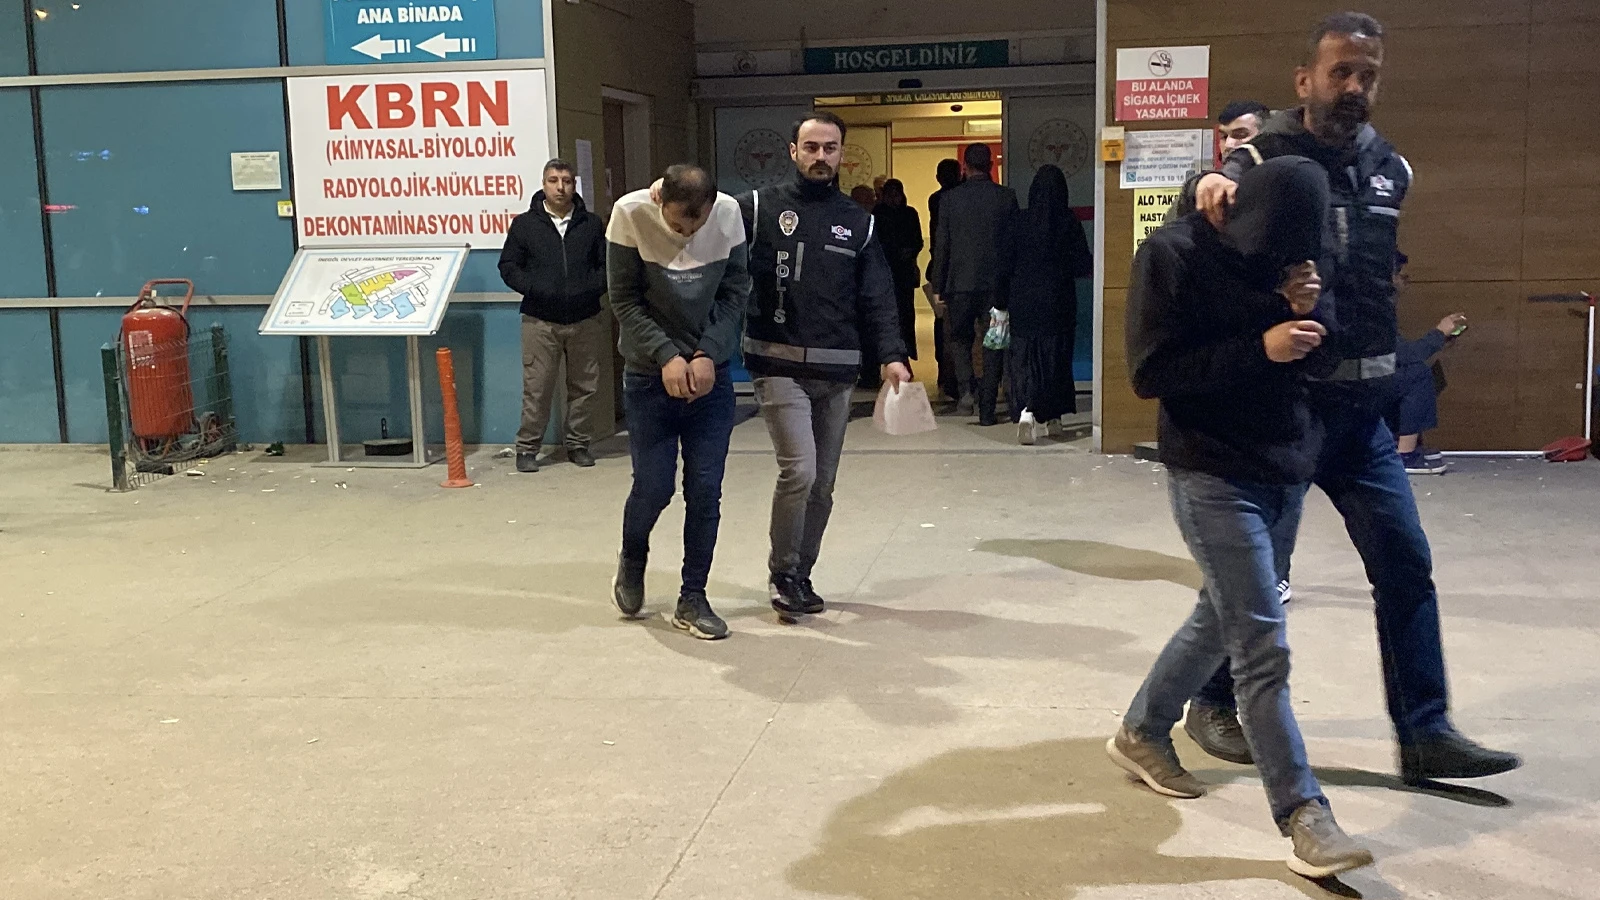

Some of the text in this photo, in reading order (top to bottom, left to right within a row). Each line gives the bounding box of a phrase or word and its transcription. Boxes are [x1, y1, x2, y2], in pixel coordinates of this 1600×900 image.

[357, 2, 463, 24] ANA BİNADA
[834, 44, 978, 71] HOŞGELDİNİZ
[1131, 80, 1193, 92] BU ALANDA
[326, 80, 510, 131] KBRN
[1123, 93, 1200, 106] SİGARA İÇMEK
[1135, 108, 1188, 119] YASAKTIR
[326, 132, 516, 166] (KİMYASAL-BİYOLOJİK
[323, 172, 524, 200] RADYOLOJİK-NÜKLEER)
[1137, 195, 1155, 206] ALO
